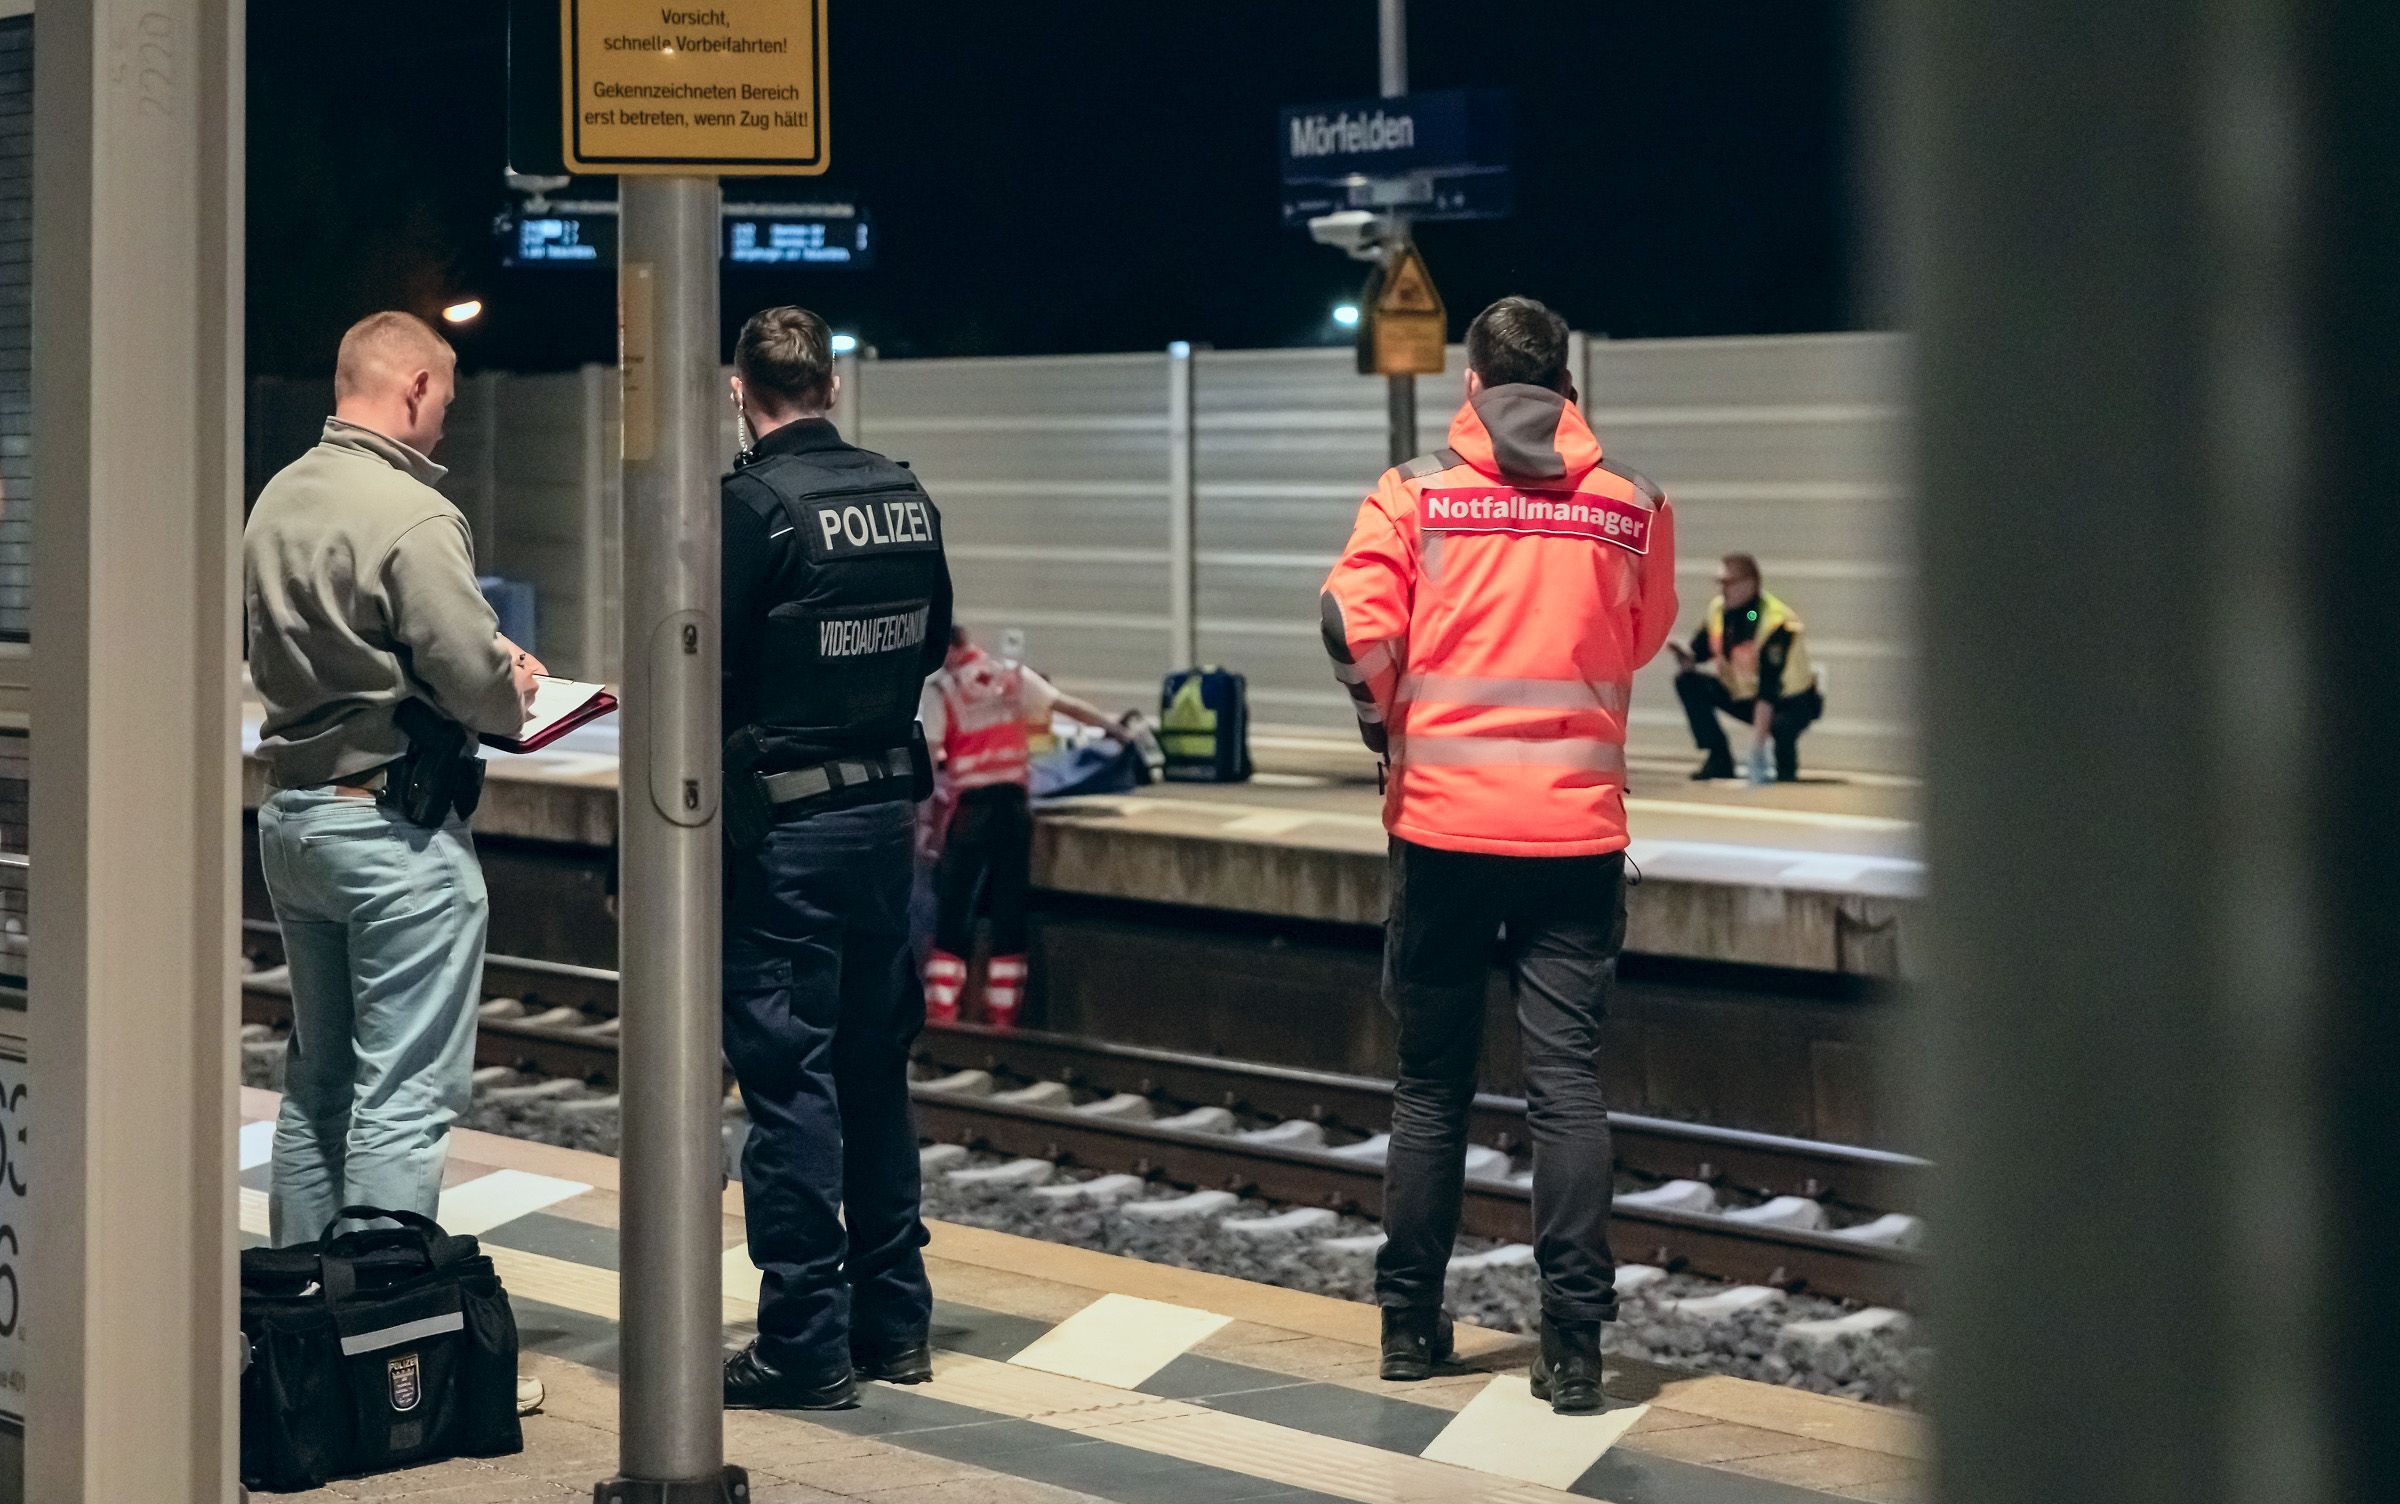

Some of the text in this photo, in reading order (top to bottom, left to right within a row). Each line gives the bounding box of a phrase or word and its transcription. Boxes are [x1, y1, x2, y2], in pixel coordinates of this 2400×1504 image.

[662, 9, 730, 28] Vorsicht,
[604, 36, 787, 54] schnelle Vorbeifahrten!
[593, 82, 799, 101] Gekennzeichneten Bereich
[585, 110, 808, 130] erst betreten, wenn Zug hält!
[1291, 110, 1415, 158] Mörfelden
[818, 502, 932, 551] POLIZEI
[1428, 496, 1644, 538] Notfallmanager
